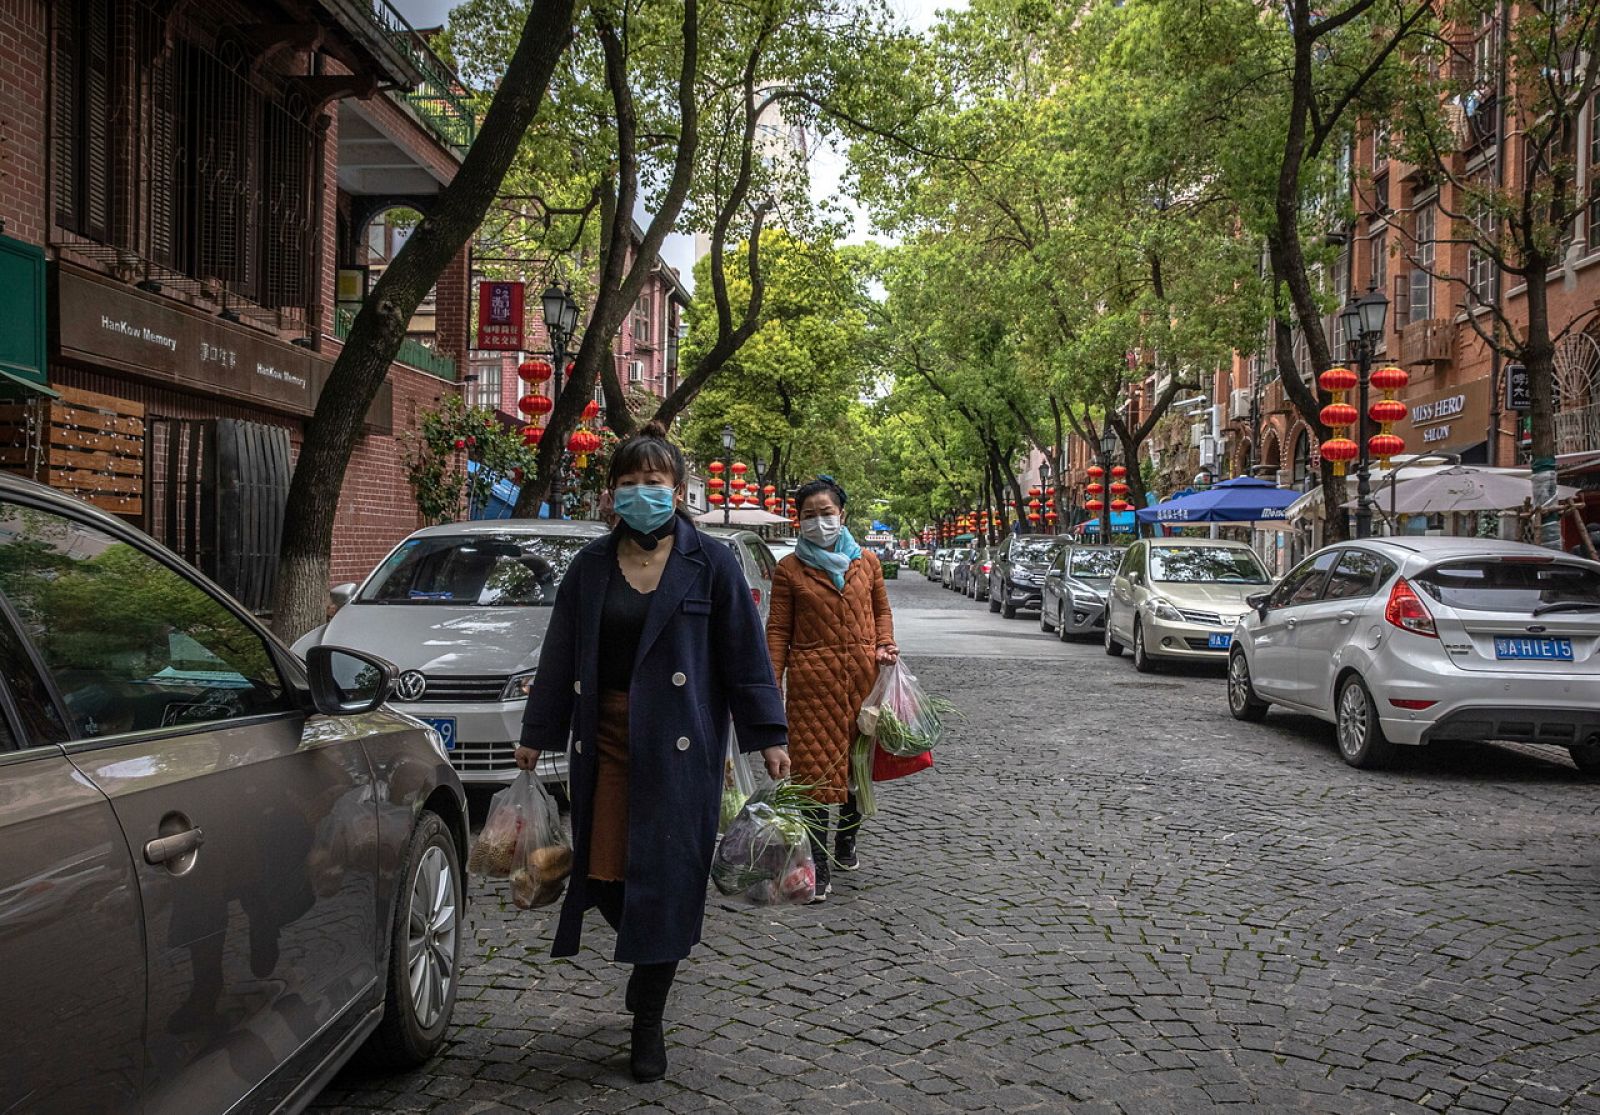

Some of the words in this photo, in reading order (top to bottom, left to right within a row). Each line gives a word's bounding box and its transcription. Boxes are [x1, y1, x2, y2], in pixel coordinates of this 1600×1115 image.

[101, 315, 141, 338] HanKow
[143, 327, 177, 352] Memory
[1411, 404, 1432, 422] MISS
[1434, 394, 1465, 417] HERO
[1423, 425, 1450, 442] SALON
